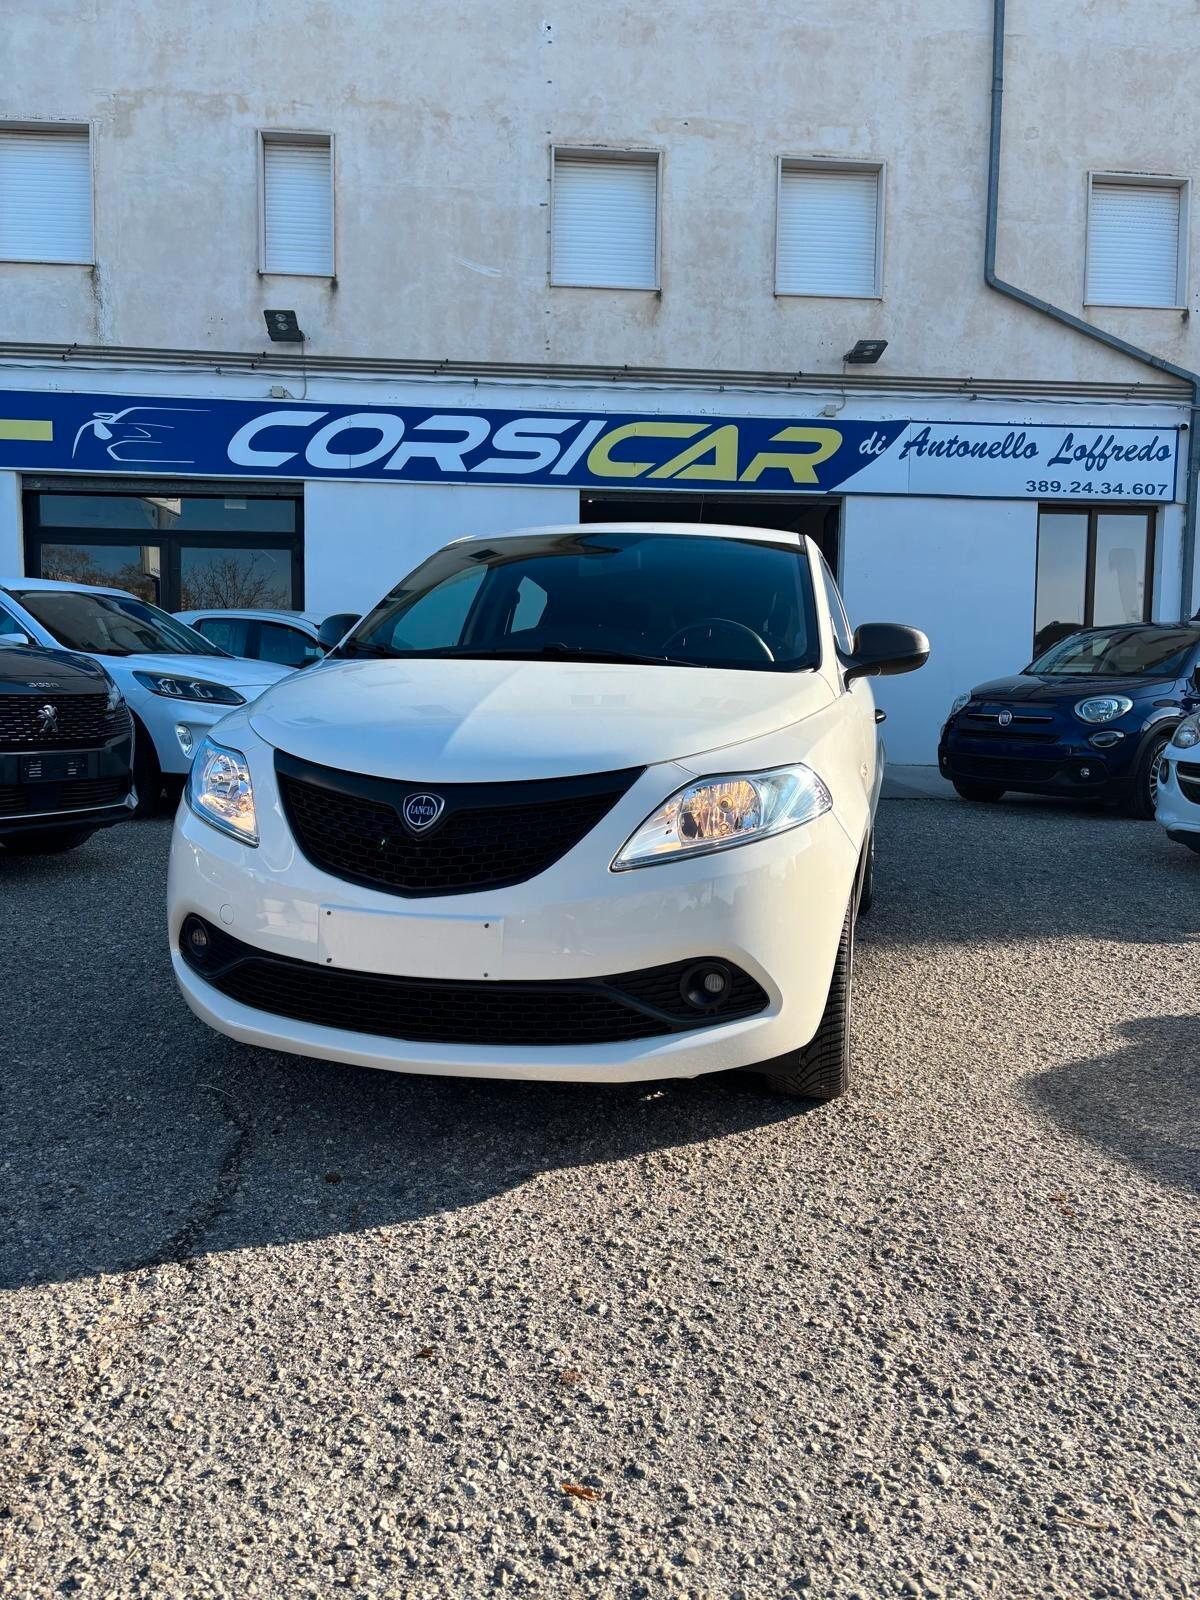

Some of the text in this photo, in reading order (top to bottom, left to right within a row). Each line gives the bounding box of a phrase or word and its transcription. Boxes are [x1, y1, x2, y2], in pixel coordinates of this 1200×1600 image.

[227, 411, 1171, 484] CORSICAR di Antonello Loffredo
[1025, 480, 1169, 496] 389.24.34.607
[410, 806, 433, 815] LANCIA
